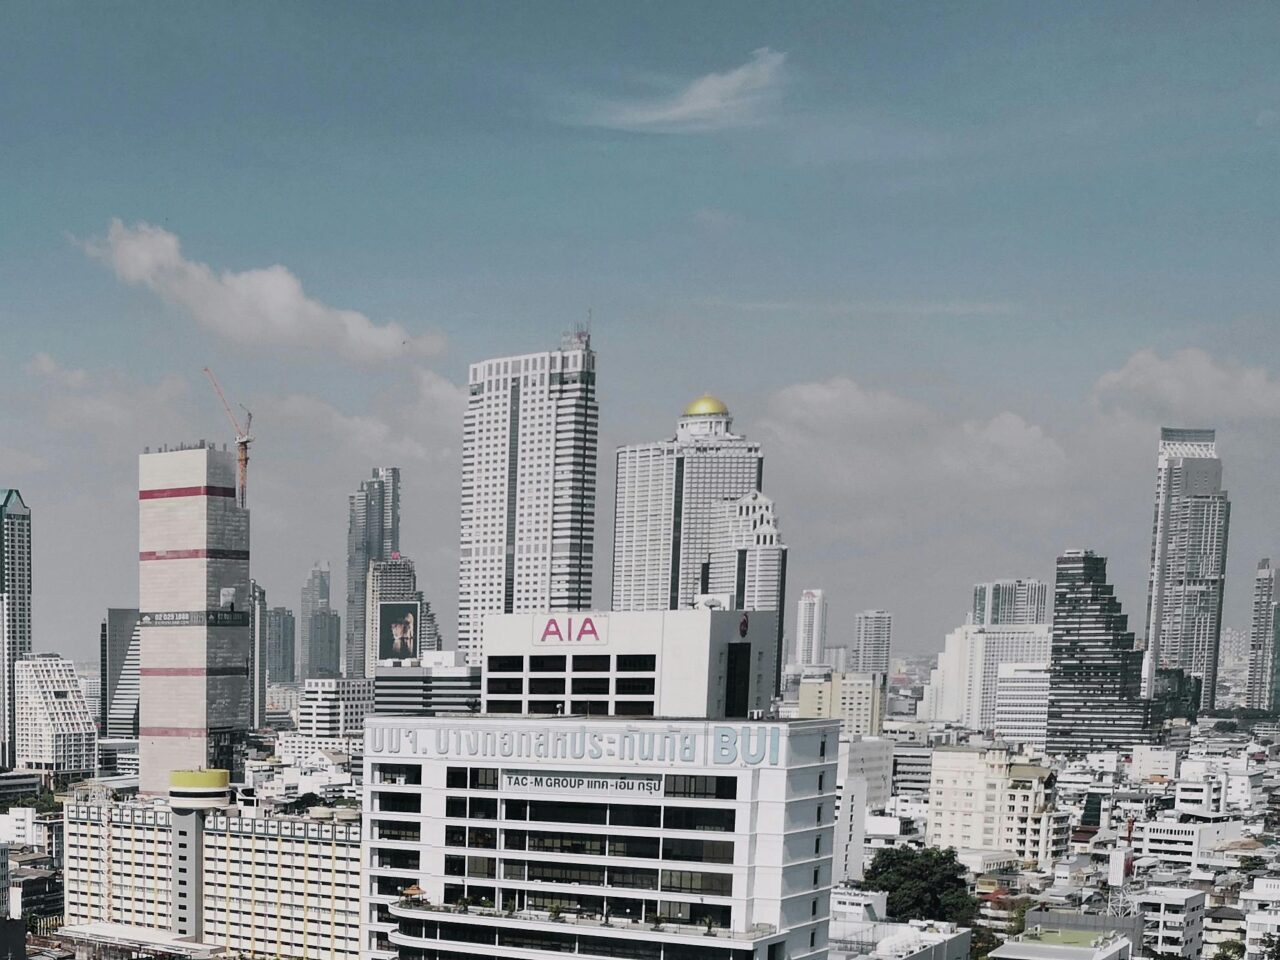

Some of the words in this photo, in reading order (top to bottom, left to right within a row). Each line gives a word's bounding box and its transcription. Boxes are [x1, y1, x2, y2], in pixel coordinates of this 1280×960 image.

[541, 617, 600, 642] AIA
[436, 724, 696, 762] บางกอกสหประกันภัย
[713, 726, 781, 766] BUI
[545, 777, 584, 789] GROUP
